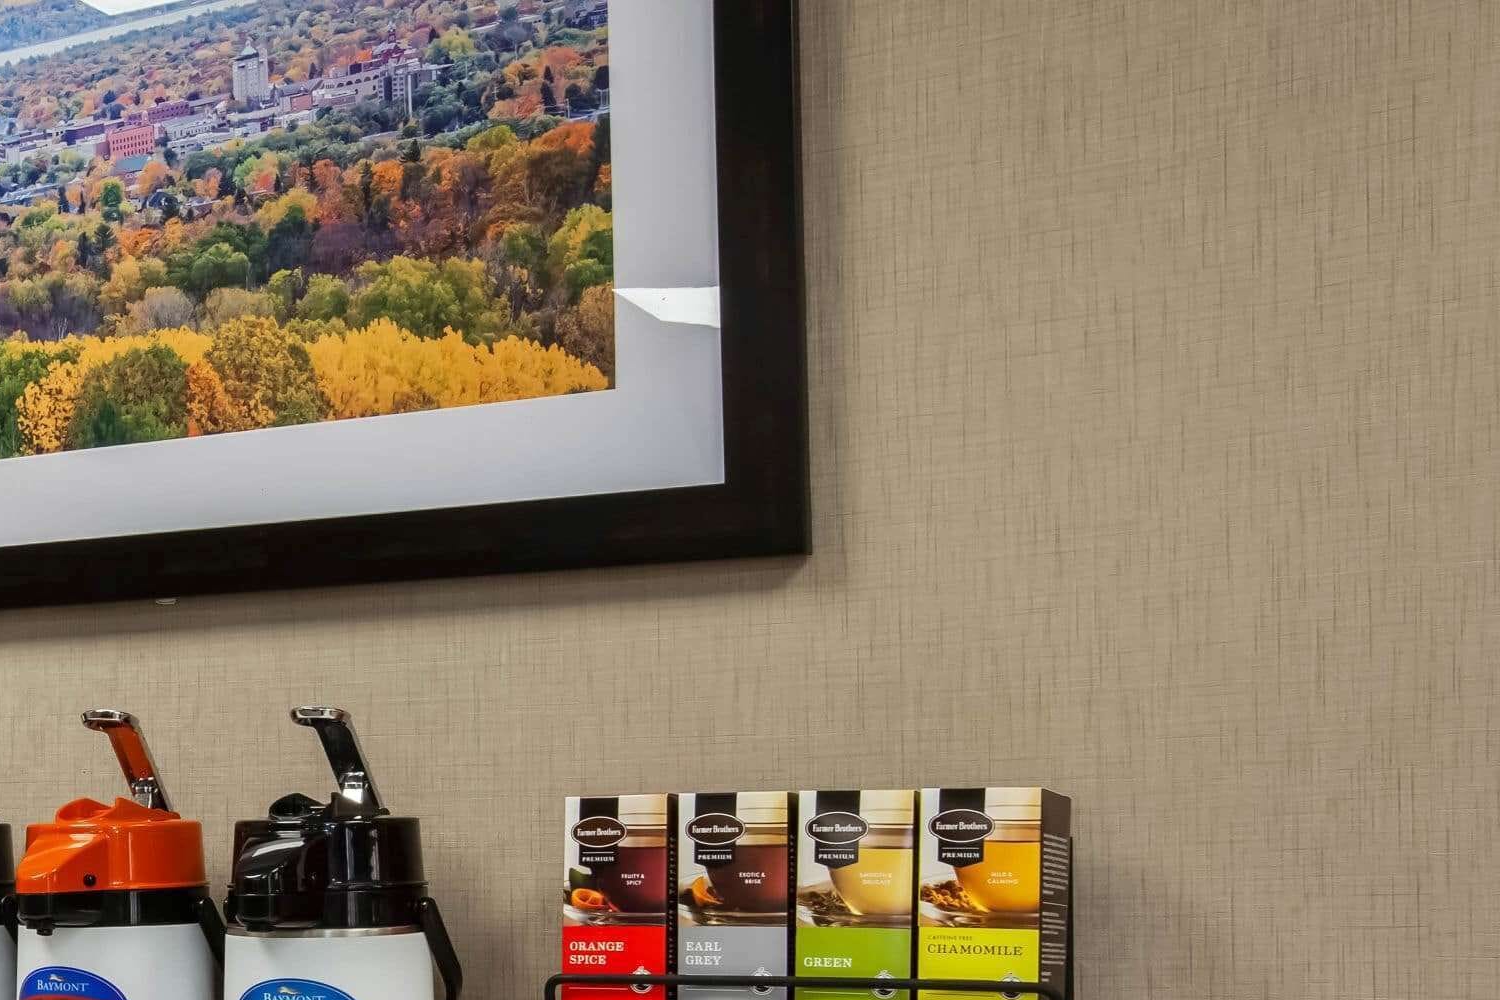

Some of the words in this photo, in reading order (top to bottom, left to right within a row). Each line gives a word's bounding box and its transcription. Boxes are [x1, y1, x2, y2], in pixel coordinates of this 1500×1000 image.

[935, 821, 958, 831] Farmer
[959, 821, 989, 831] Brothers
[569, 941, 624, 952] ORANGE
[685, 941, 722, 952] EARL
[927, 943, 1024, 957] CHAMOMILE
[569, 954, 606, 965] SPICE
[685, 954, 722, 966] GREY
[803, 956, 853, 969] GREEN
[37, 979, 89, 992] BAYMONT
